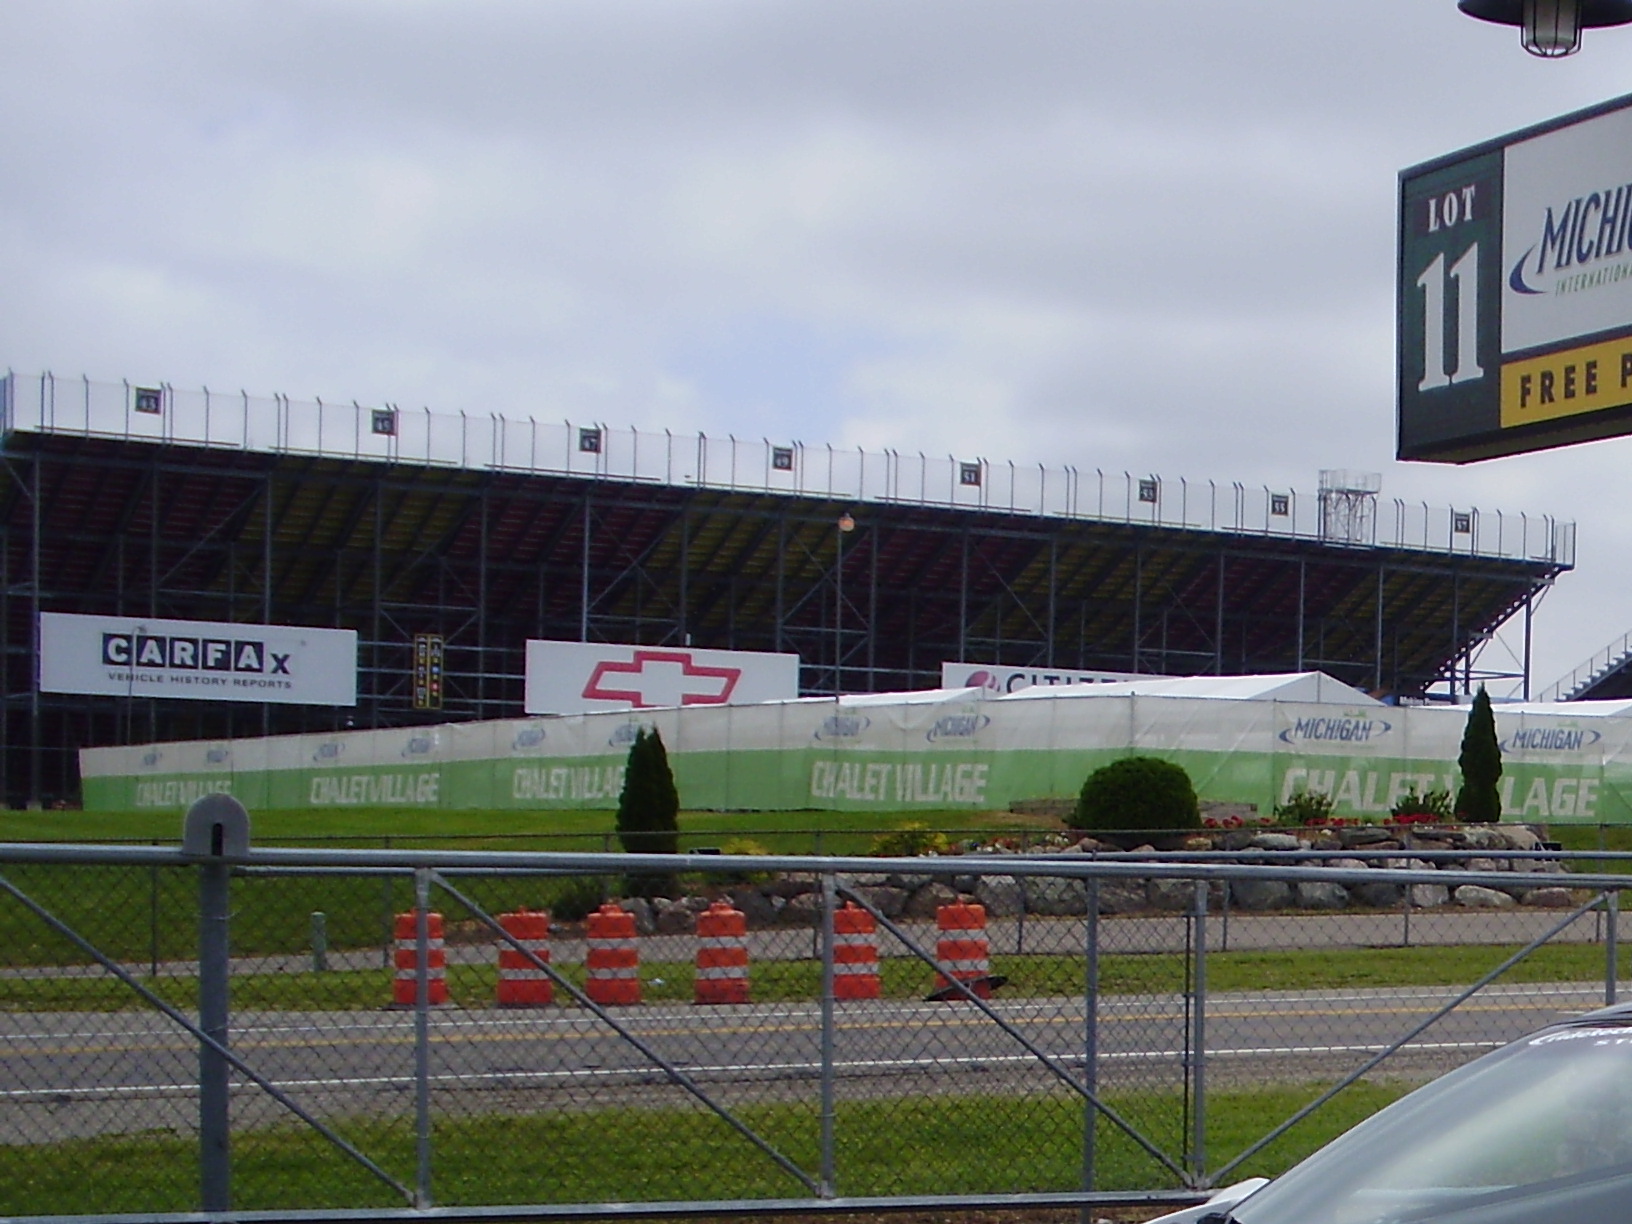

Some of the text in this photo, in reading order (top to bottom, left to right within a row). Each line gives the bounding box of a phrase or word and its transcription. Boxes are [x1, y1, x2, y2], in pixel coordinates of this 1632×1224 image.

[1428, 185, 1475, 232] LOT
[1417, 241, 1484, 391] 11
[1520, 360, 1597, 408] FREE
[103, 633, 291, 674] CARFAX
[108, 673, 292, 689] VEHICLE HISTORY REPORTS
[1294, 716, 1374, 742] MICHIGAN
[1511, 728, 1584, 751] MICHIGAN
[310, 773, 441, 804] CHALET VILLAGE
[512, 768, 569, 799] CHALET
[811, 761, 989, 802] CHALET VILLAGE
